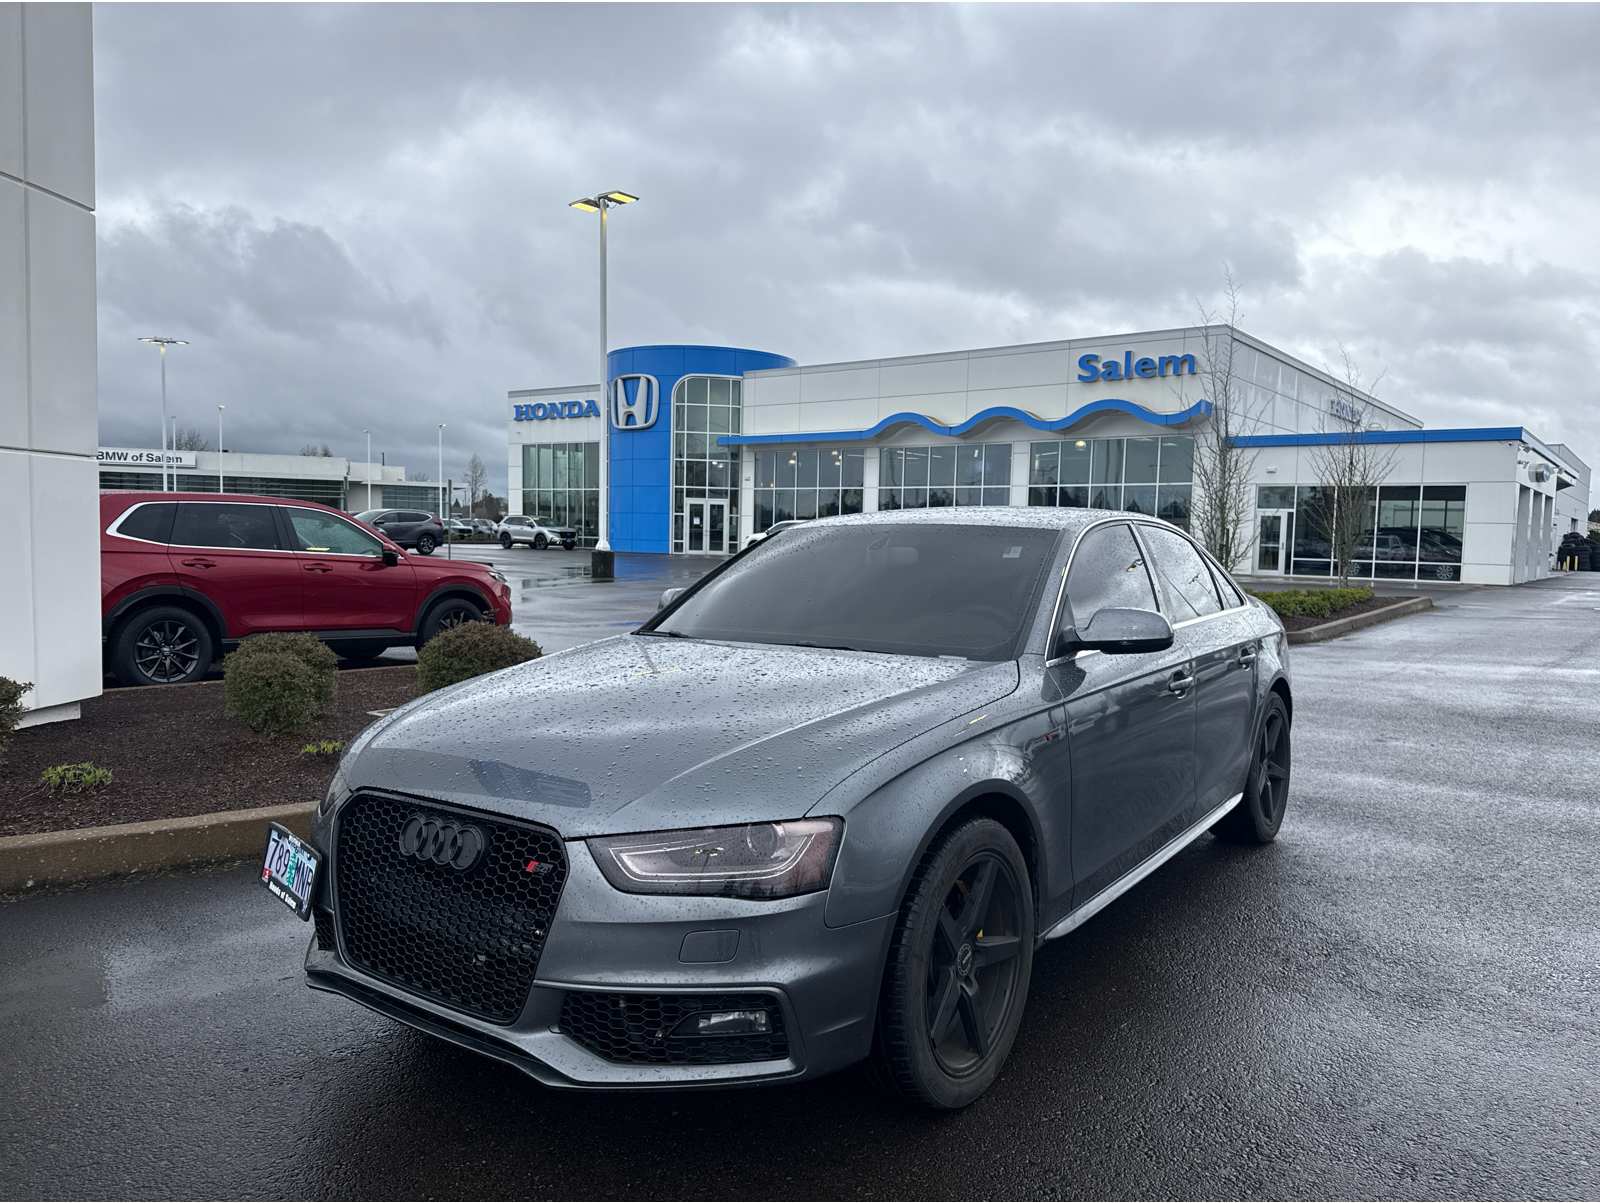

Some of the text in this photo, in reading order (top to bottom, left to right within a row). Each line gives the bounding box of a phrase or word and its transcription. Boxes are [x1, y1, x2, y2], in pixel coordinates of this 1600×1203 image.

[1078, 351, 1197, 383] Salem
[513, 400, 600, 422] HONDA
[131, 453, 143, 462] of
[269, 838, 290, 878] 789
